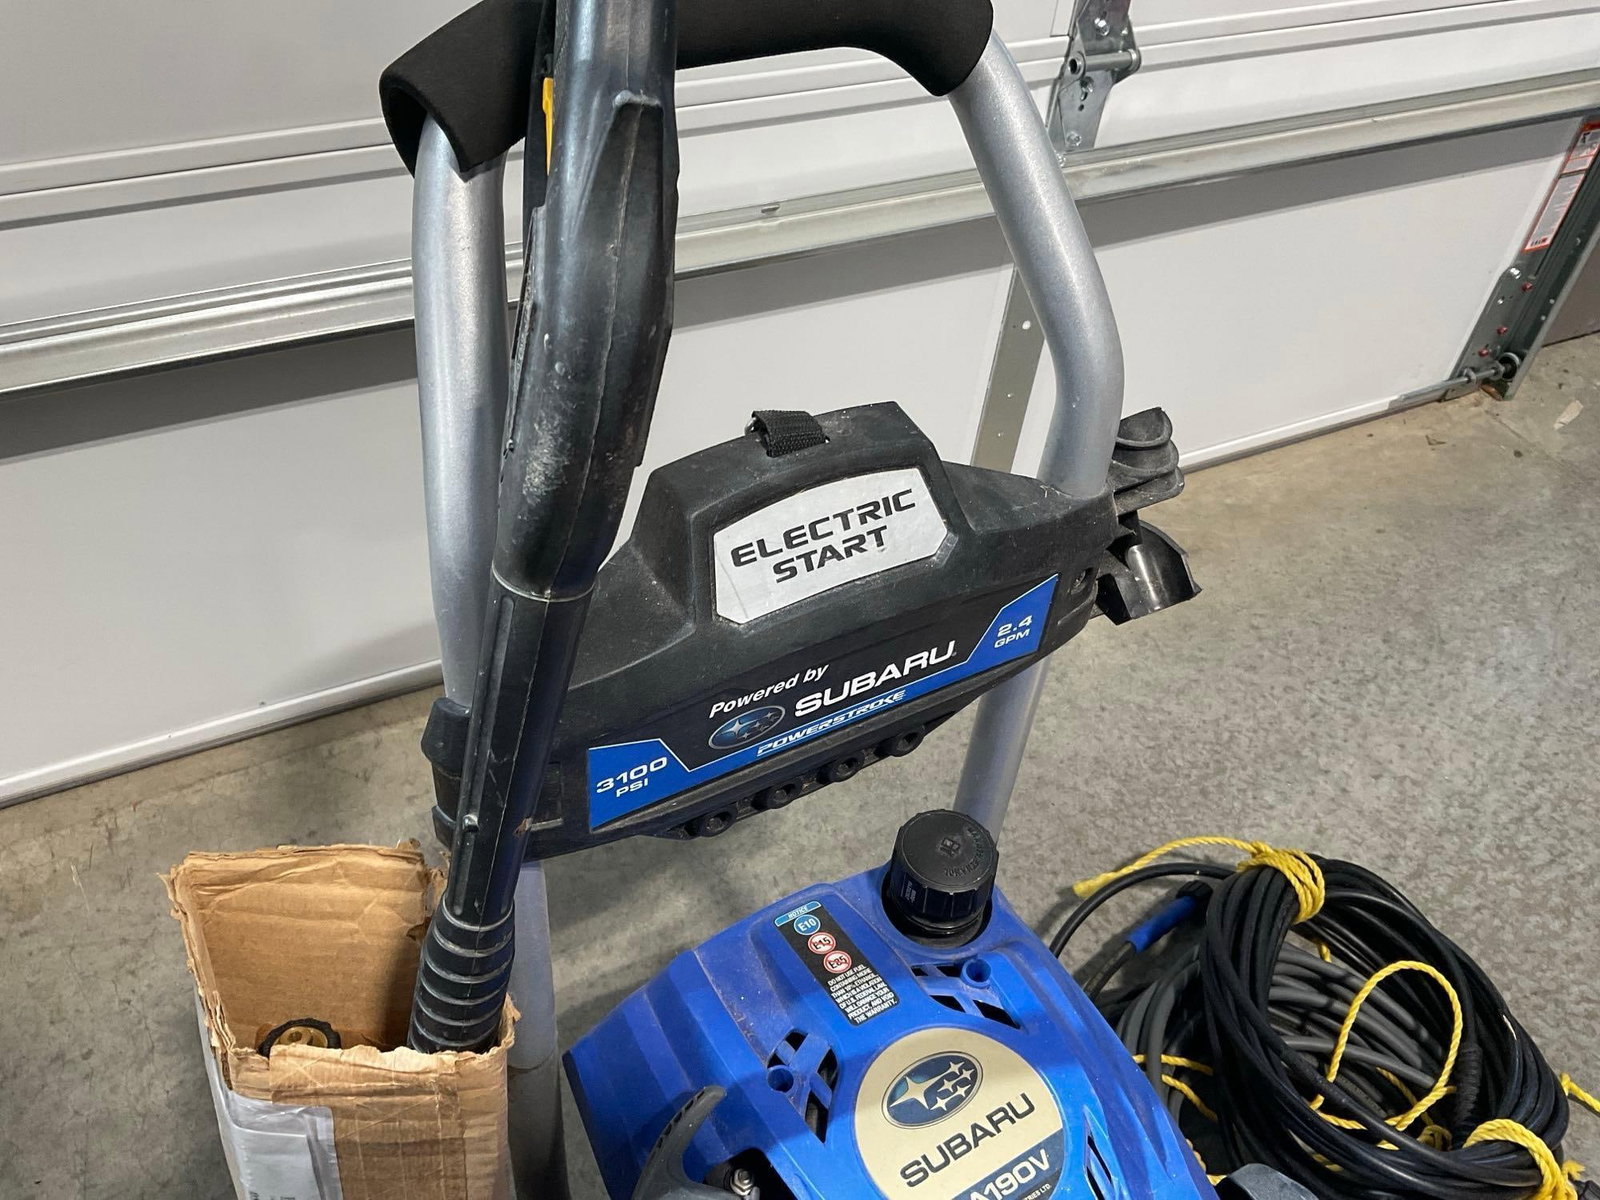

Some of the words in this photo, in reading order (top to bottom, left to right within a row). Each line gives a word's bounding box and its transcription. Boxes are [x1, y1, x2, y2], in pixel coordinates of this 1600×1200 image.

[731, 489, 915, 567] ELECTRIC
[773, 525, 887, 583] START
[994, 628, 1030, 648] GPM
[998, 615, 1032, 637] 2.4
[708, 674, 800, 718] Powered
[802, 664, 830, 685] by
[794, 640, 956, 717] SUBARU
[756, 690, 906, 757] POWERSTROKE
[596, 756, 668, 793] 3100
[616, 778, 648, 798] PSI
[788, 905, 808, 918] NOTICE
[798, 918, 817, 932] E10
[812, 936, 831, 950] E15
[828, 955, 848, 969] E85
[900, 1093, 1036, 1188] SUBARU
